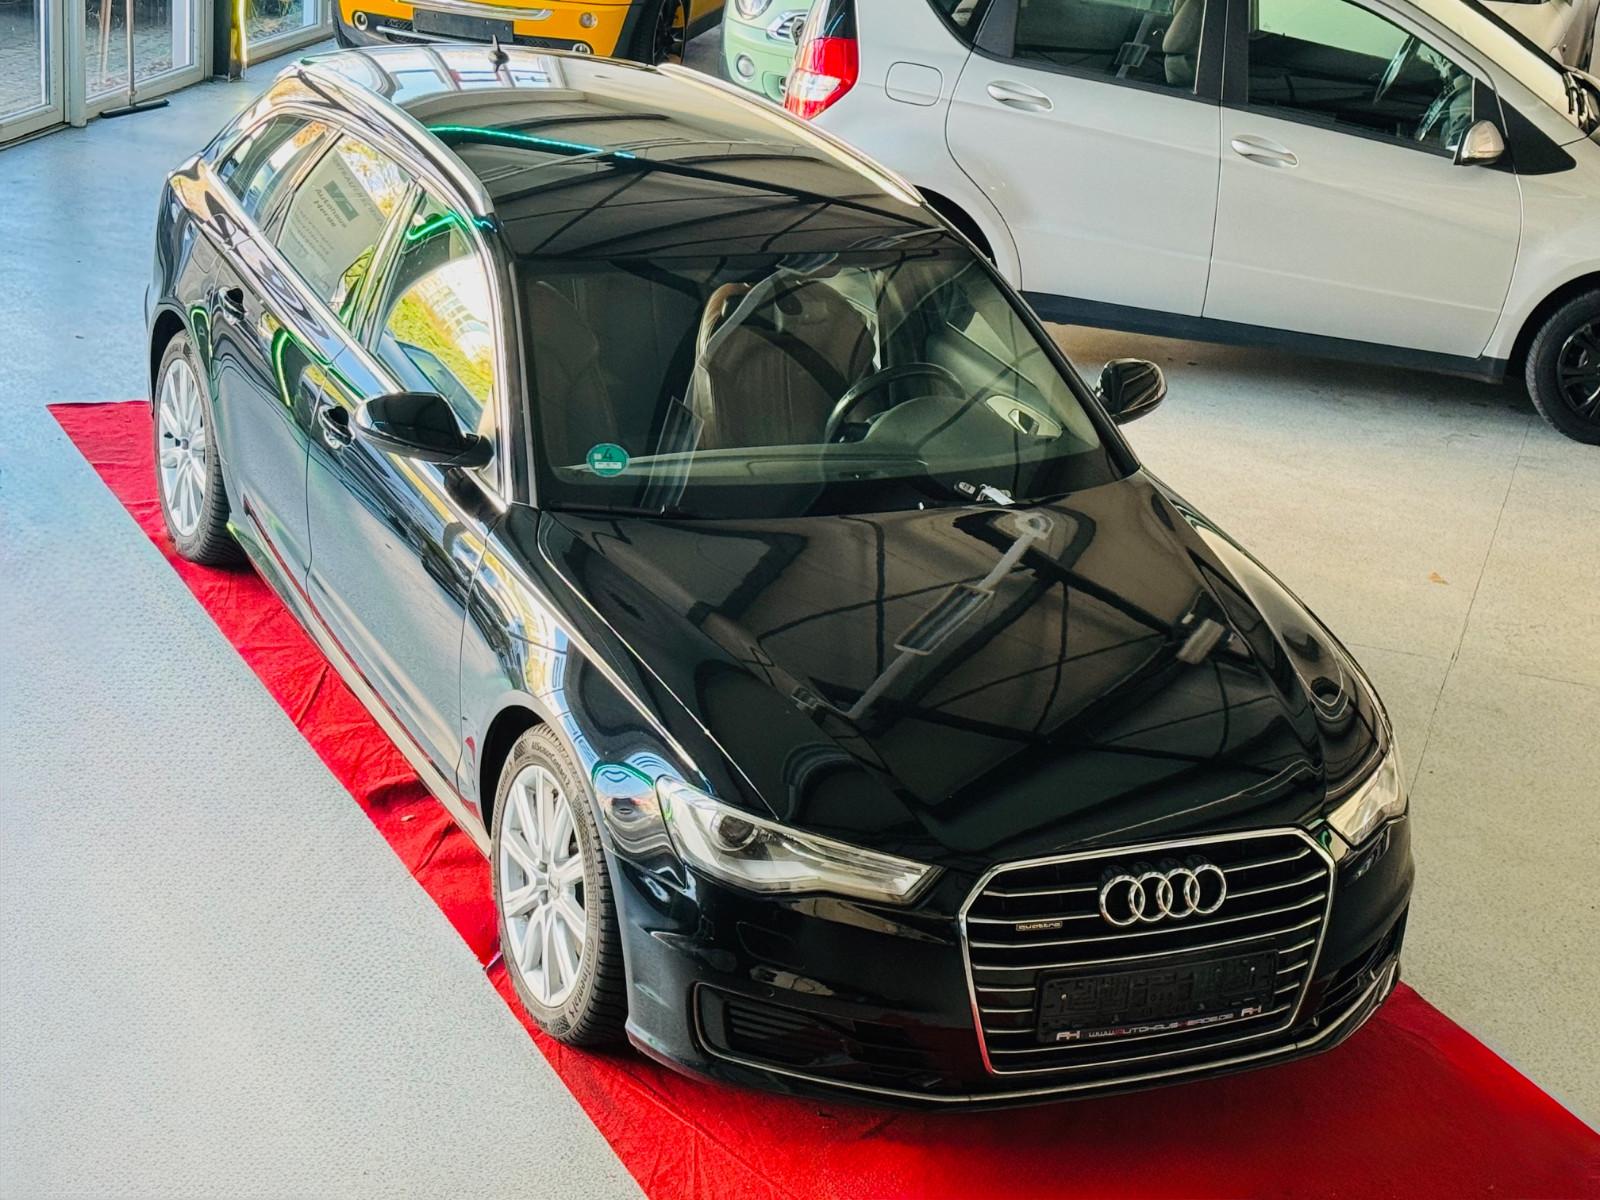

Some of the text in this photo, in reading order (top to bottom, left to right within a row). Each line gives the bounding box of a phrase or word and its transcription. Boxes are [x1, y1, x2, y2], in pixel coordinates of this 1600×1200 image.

[602, 447, 614, 461] 4
[1018, 921, 1061, 931] quattro
[1056, 1030, 1080, 1041] AH
[1240, 1004, 1262, 1017] AH
